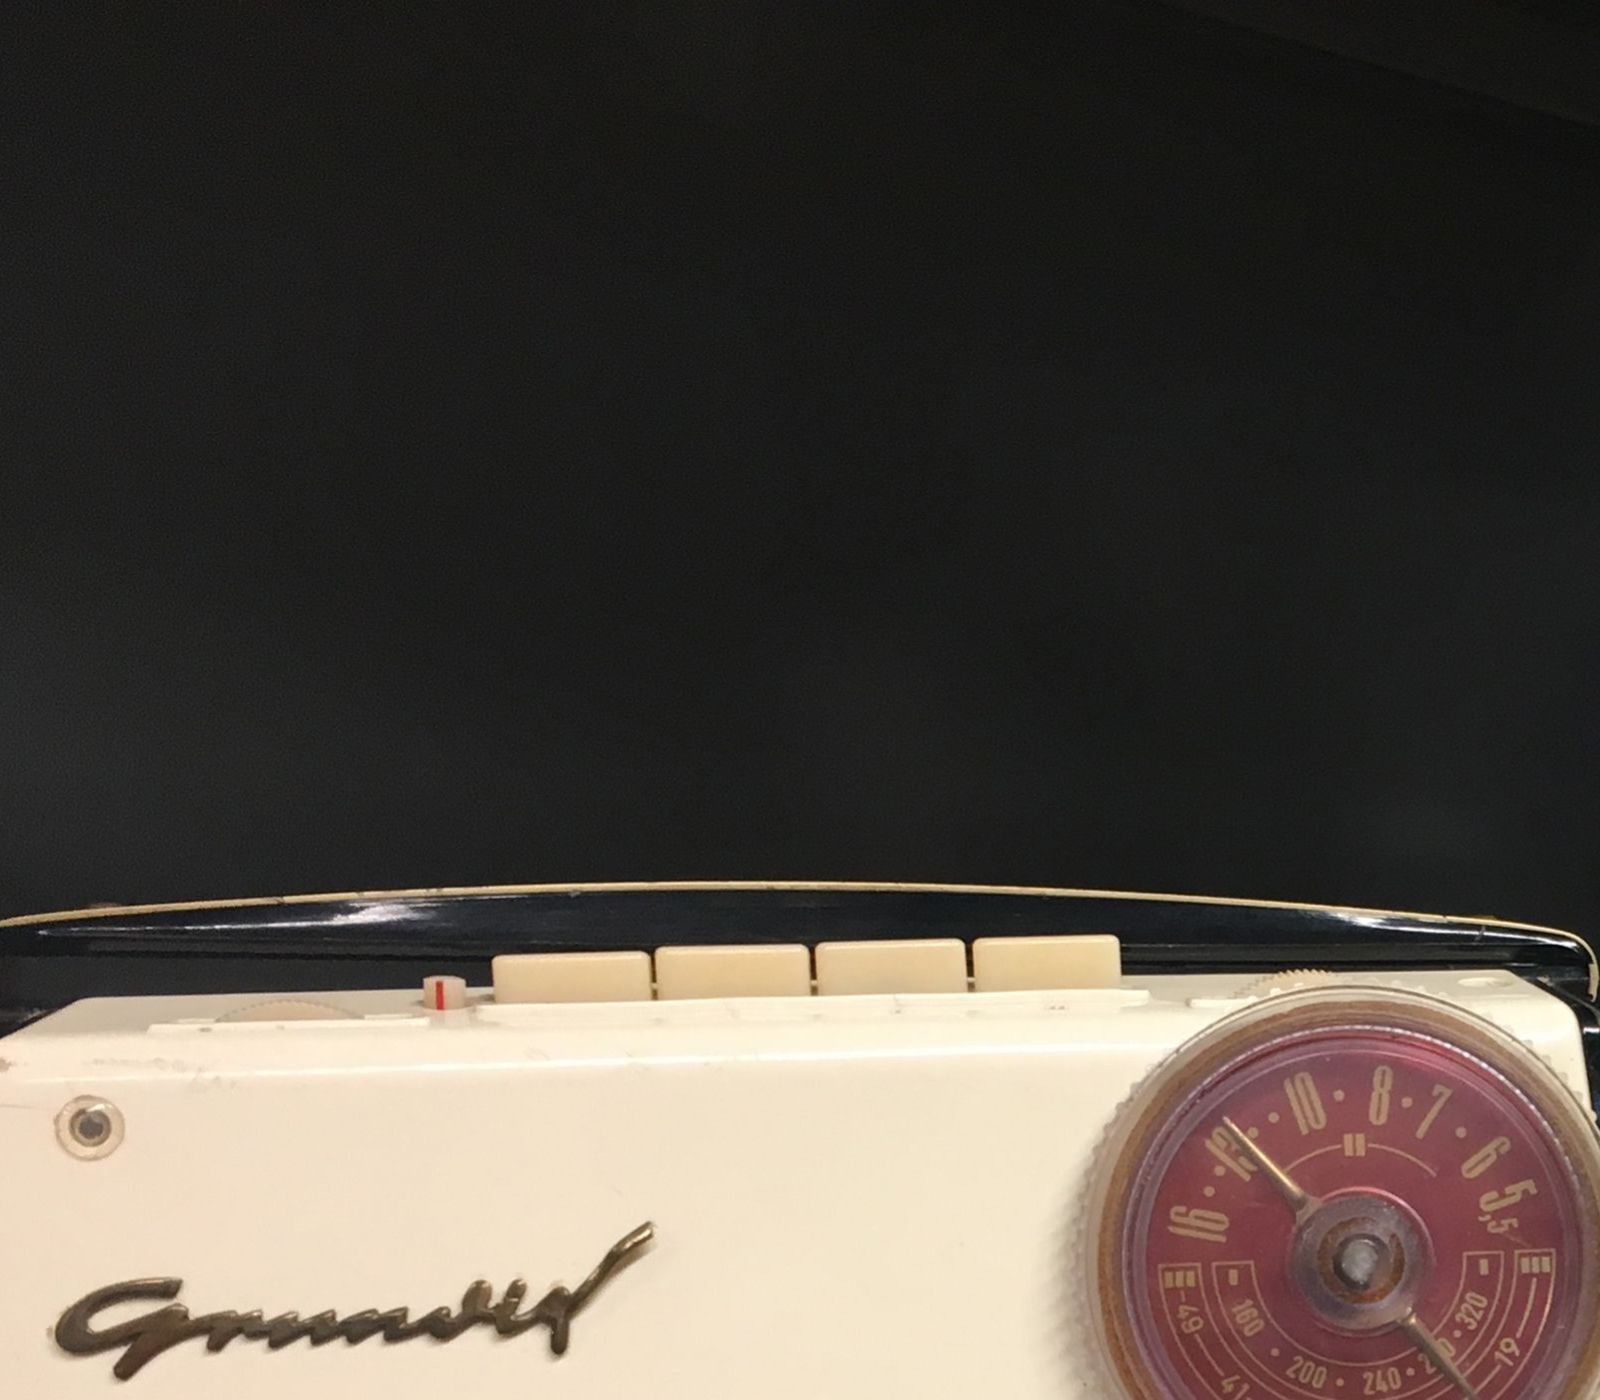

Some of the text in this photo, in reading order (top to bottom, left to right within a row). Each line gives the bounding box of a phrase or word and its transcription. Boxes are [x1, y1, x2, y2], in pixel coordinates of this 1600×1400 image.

[1167, 1205, 1230, 1243] 16
[1283, 1072, 1327, 1136] 10
[1368, 1065, 1393, 1126] 8
[1415, 1084, 1453, 1140] 7
[1461, 1136, 1512, 1179] 6
[54, 1220, 656, 1381] Grundig
[1176, 1304, 1204, 1335] 49
[1494, 1337, 1521, 1367] 19
[1286, 1355, 1328, 1389] 200
[1363, 1367, 1402, 1396] 240
[1418, 1338, 1456, 1375] 20
[1455, 1291, 1489, 1331] 320
